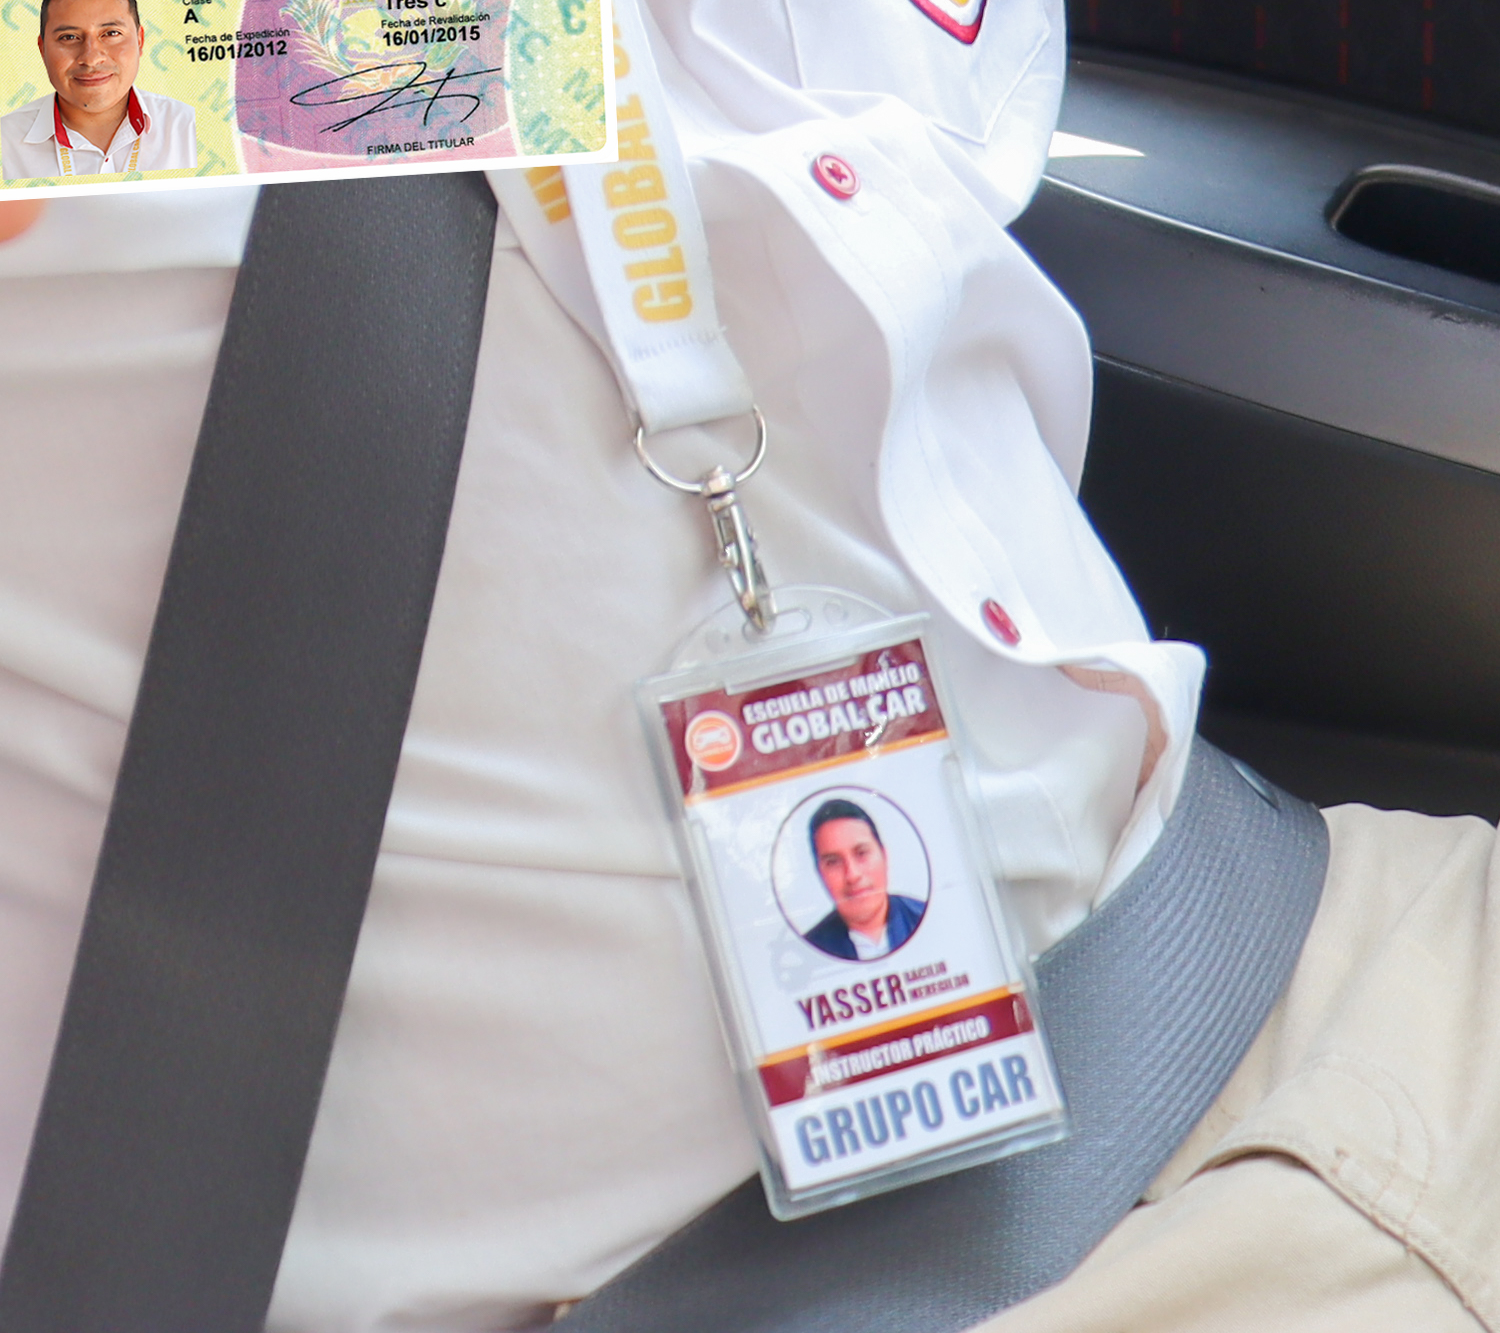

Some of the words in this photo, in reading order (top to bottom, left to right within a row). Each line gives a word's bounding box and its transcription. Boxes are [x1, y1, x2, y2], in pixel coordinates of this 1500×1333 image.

[183, 9, 199, 24] A
[185, 34, 217, 44] Fecha
[220, 33, 233, 42] de
[235, 28, 290, 42] Expedición
[381, 18, 412, 29] Fecha
[413, 16, 426, 26] de
[428, 12, 490, 26] Revalidación
[382, 25, 481, 48] 16/01/2015
[187, 40, 287, 62] 16/01/2012
[367, 143, 401, 155] FIRMA
[403, 141, 426, 152] DEL
[427, 137, 475, 151] TITULAR
[601, 93, 694, 324] GLOBAL
[743, 687, 824, 725] ESCUELA
[823, 681, 850, 704] DE
[849, 662, 921, 698] MANEJO
[752, 701, 871, 754] GLOBAL
[866, 685, 928, 724] CAR
[796, 973, 907, 1031] YASSER
[811, 1037, 914, 1086] INSTRUCTOR
[913, 1015, 992, 1056] PRÁCTICO
[795, 1080, 945, 1168] GRUPO
[949, 1053, 1037, 1121] CAR
